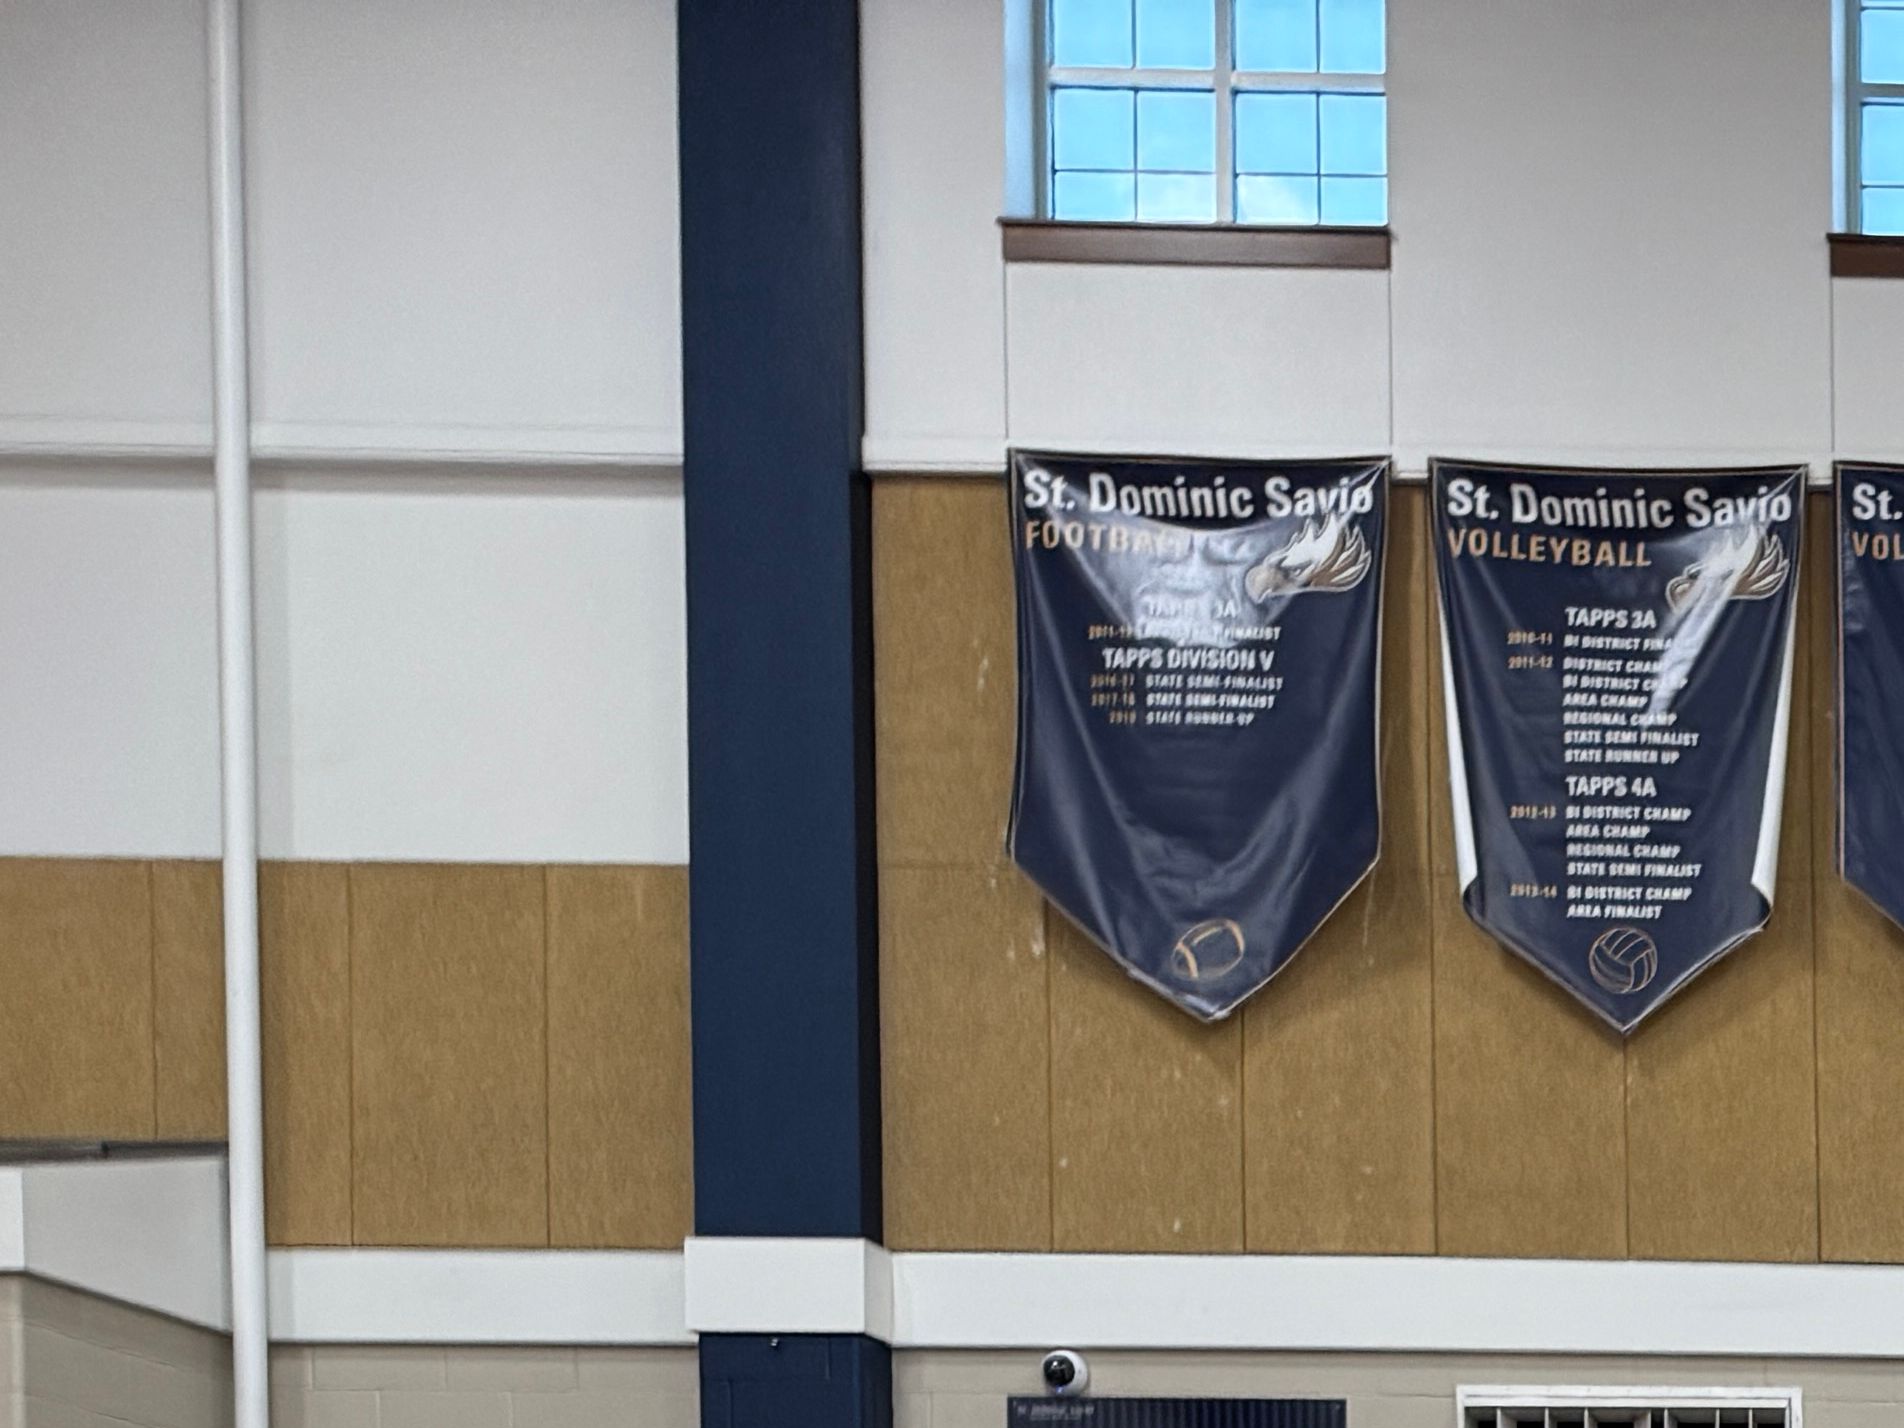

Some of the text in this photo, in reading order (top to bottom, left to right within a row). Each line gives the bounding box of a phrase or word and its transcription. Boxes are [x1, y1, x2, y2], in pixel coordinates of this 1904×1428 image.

[1023, 469, 1374, 518] St. Dominic Savio
[1447, 478, 1791, 529] St. Dominic Savio
[1852, 483, 1902, 522] St.
[1448, 528, 1652, 567] VOLLEYBALL
[1565, 606, 1628, 629] TAPPS
[1102, 648, 1163, 669] TAPPS
[1167, 648, 1256, 670] DIVISION
[1565, 776, 1657, 798] TAPPS 4A
